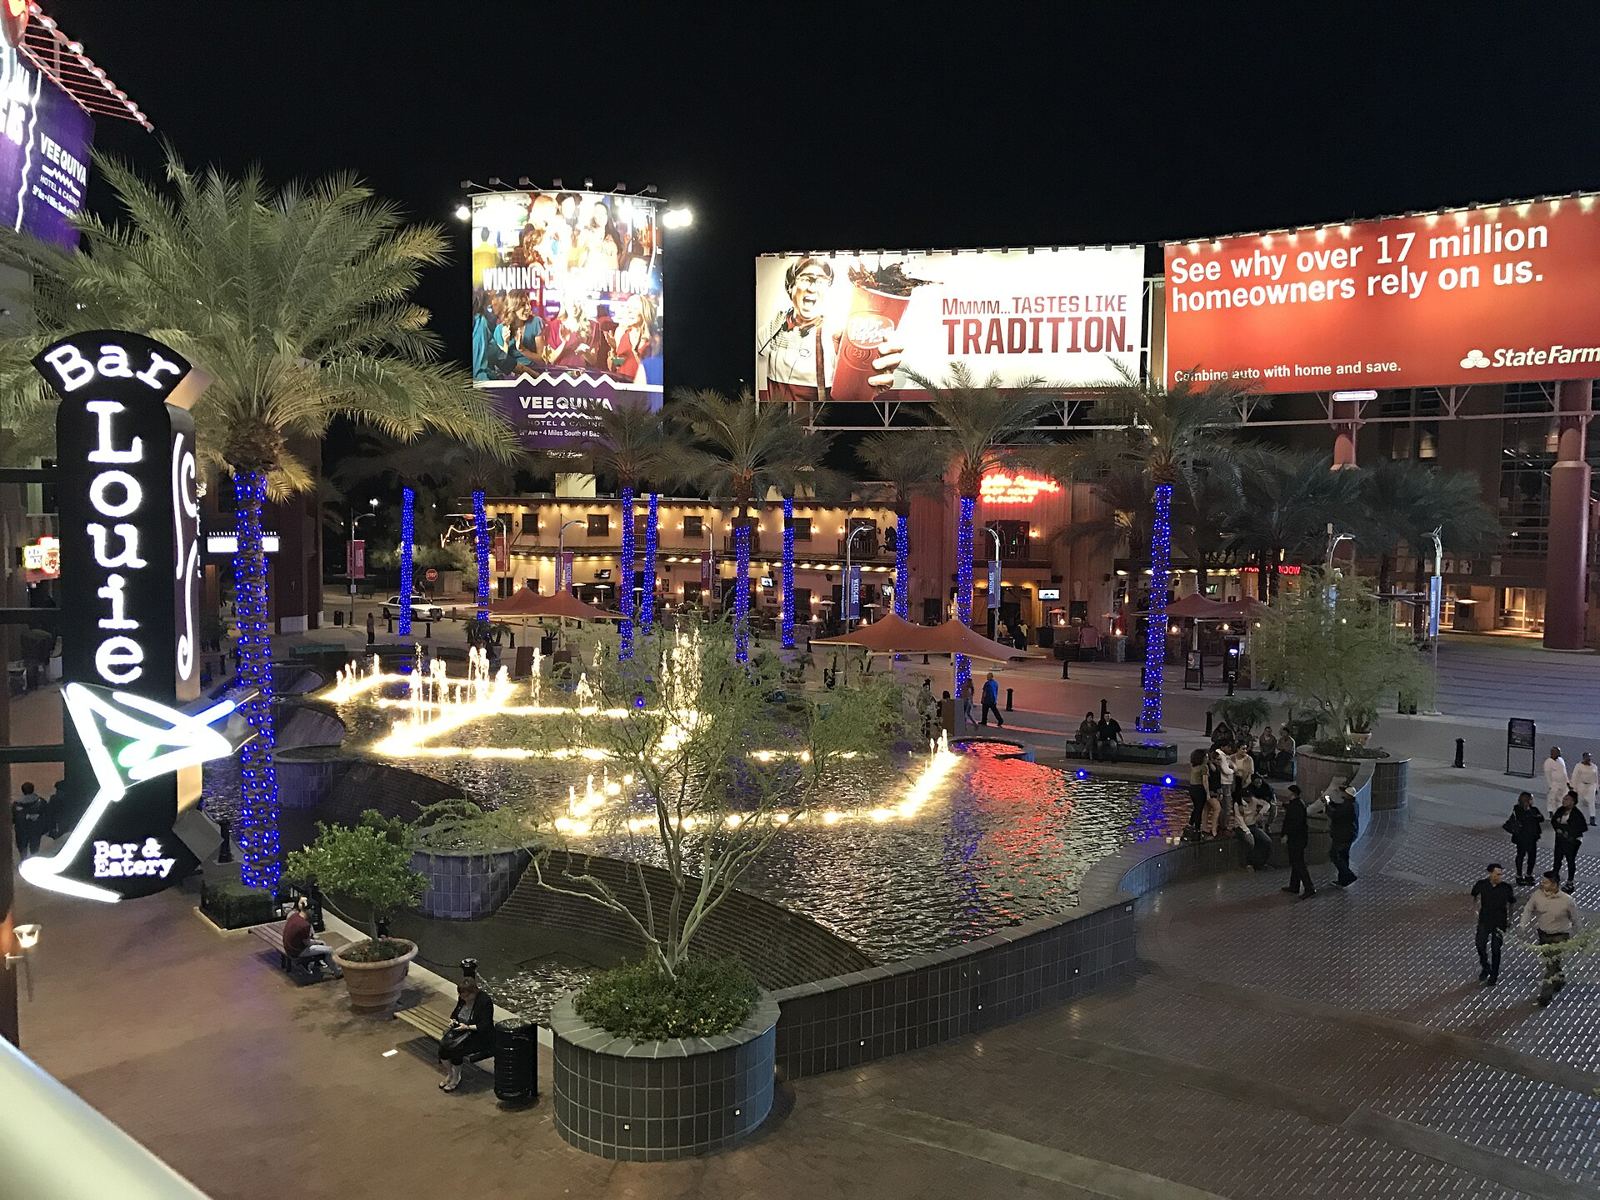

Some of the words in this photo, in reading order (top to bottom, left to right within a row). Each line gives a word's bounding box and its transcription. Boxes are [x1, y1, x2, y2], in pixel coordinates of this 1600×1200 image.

[41, 131, 61, 166] VEE
[60, 149, 87, 187] QUIVA
[1170, 257, 1222, 284] See
[1230, 249, 1288, 280] why
[1296, 245, 1364, 273] over
[1376, 231, 1416, 264] 17
[1428, 222, 1548, 260] million
[483, 266, 541, 291] WINNING
[1172, 276, 1356, 313] homeowners
[1367, 264, 1428, 299] rely
[1438, 265, 1480, 291] on
[1493, 260, 1543, 286] us.
[1085, 295, 1127, 312] LIKE
[942, 316, 1134, 355] TRADITION.
[44, 344, 181, 392] Bar
[1232, 368, 1260, 379] auto
[1263, 365, 1290, 378] with
[1295, 364, 1331, 377] home
[1336, 361, 1362, 375] and
[1366, 362, 1401, 373] save.
[519, 397, 554, 409] VEE
[86, 400, 148, 684] Louie
[93, 840, 138, 860] Bar
[141, 837, 162, 858] &
[93, 858, 177, 878] Eatery
